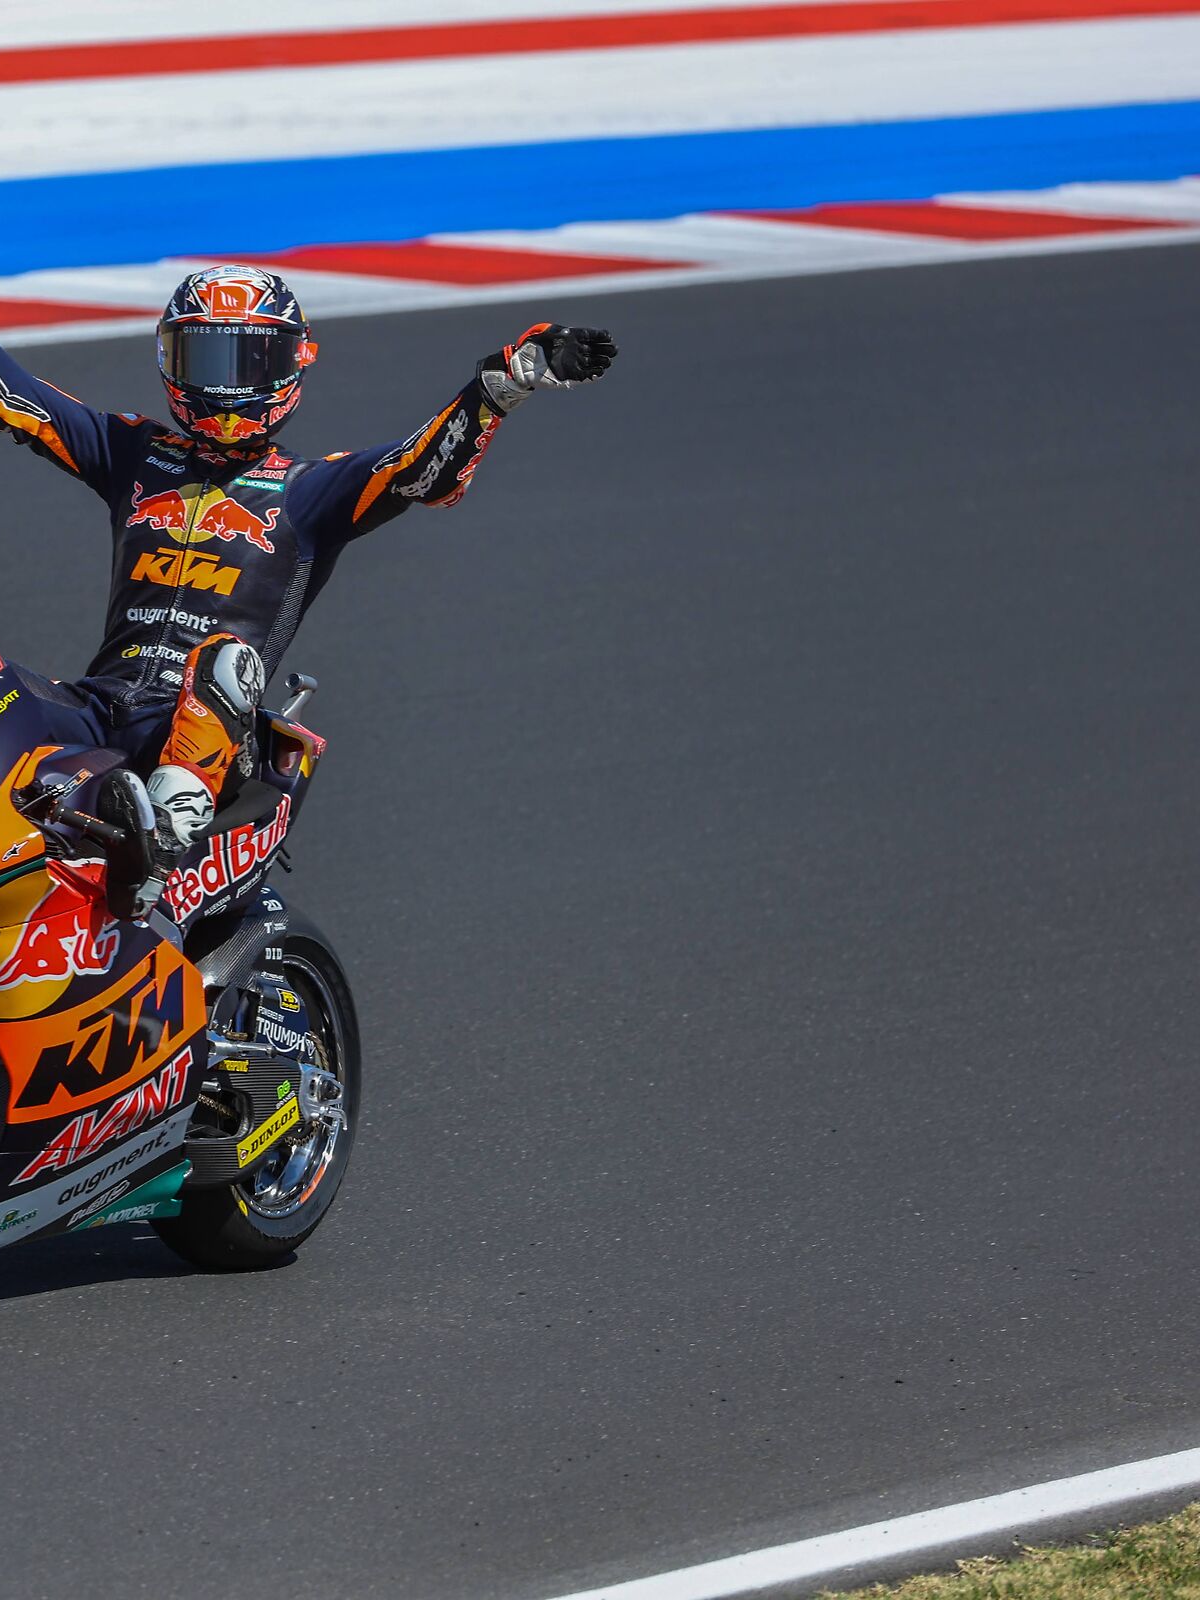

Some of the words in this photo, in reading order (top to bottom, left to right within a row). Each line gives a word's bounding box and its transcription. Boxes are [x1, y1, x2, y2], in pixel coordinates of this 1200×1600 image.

[183, 326, 211, 334] GIVES
[216, 326, 239, 334] YOU
[244, 325, 279, 335] WINGS
[130, 547, 241, 596] KTM
[139, 645, 188, 664] MOTORE
[162, 833, 229, 925] Red
[227, 793, 292, 884] Bull
[265, 948, 282, 960] DID
[13, 962, 185, 1109] KTM
[256, 1016, 306, 1052] TRIUMPH
[9, 1046, 193, 1186] AVANT
[250, 1106, 296, 1153] DUNLOP
[104, 1202, 160, 1225] MOTOREX
